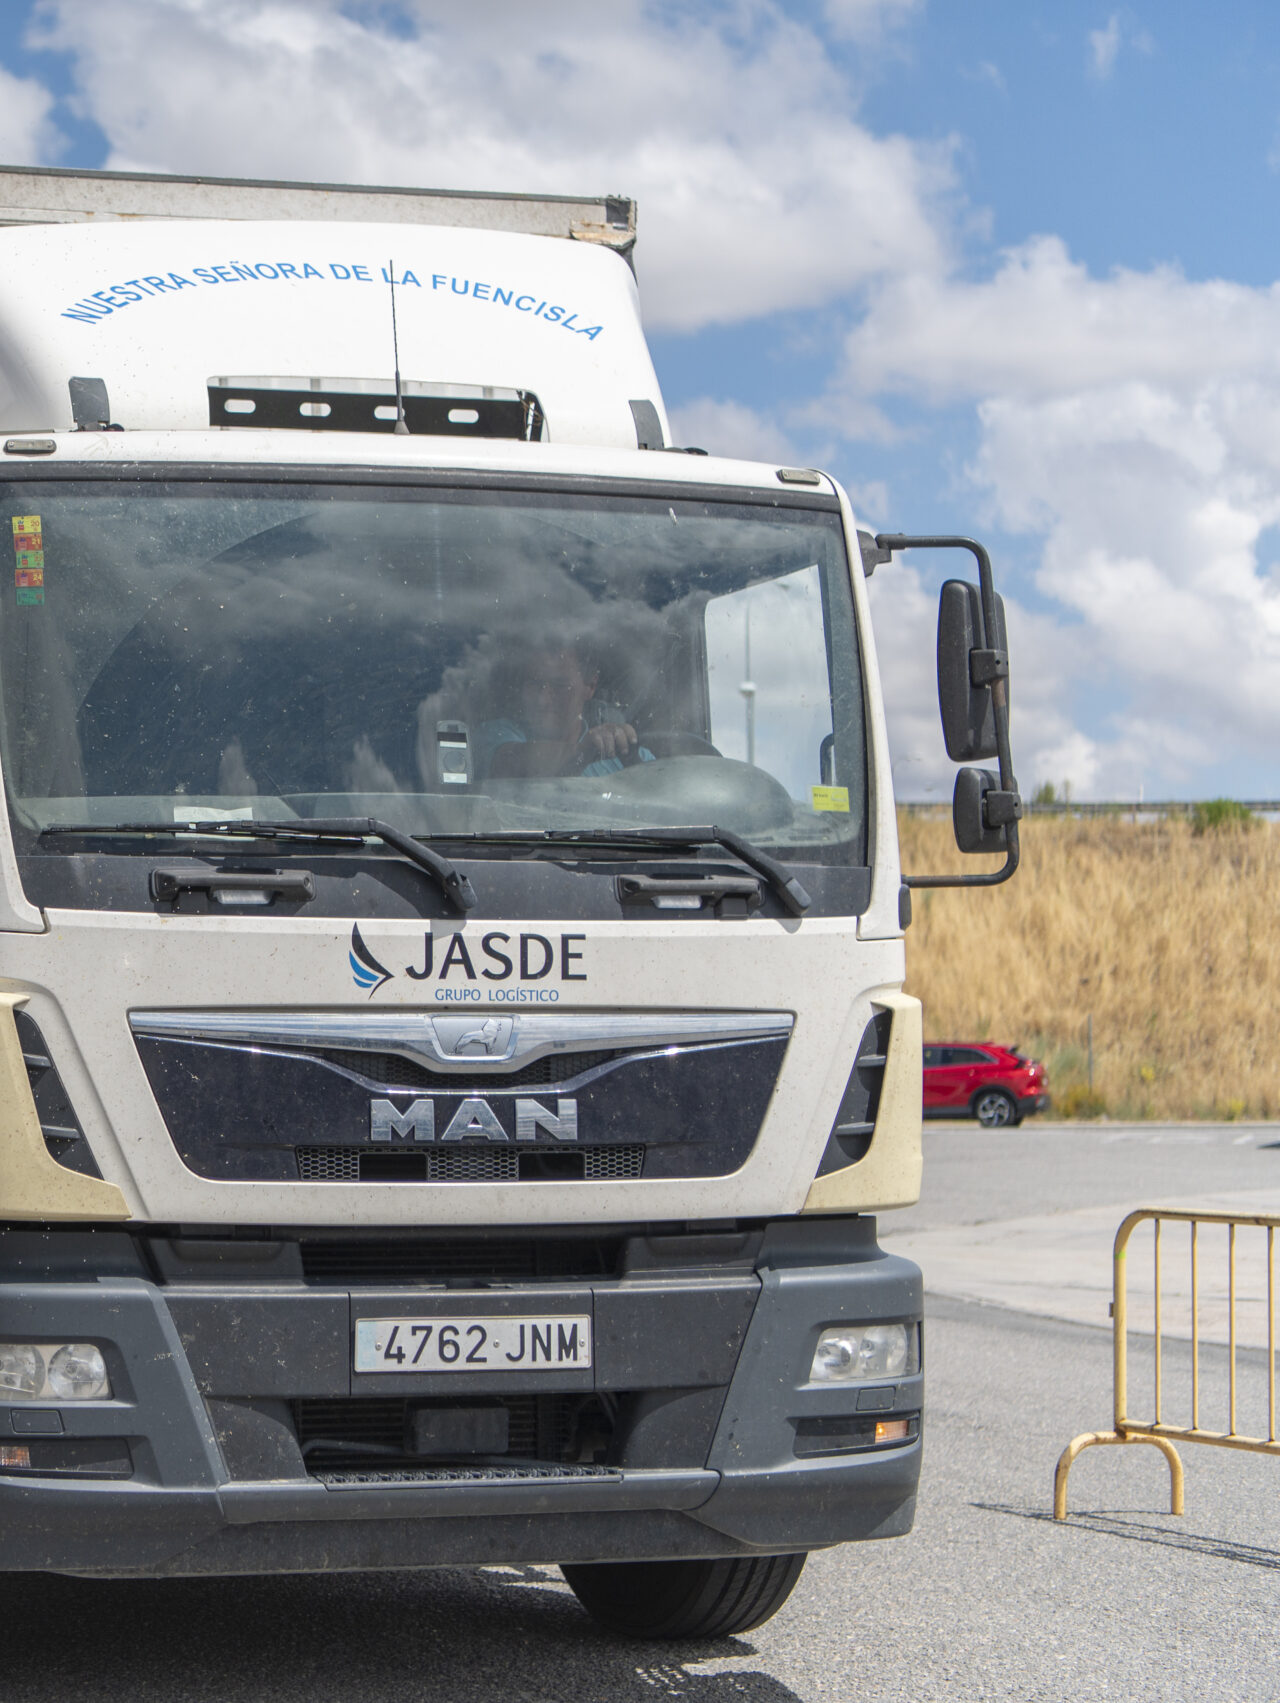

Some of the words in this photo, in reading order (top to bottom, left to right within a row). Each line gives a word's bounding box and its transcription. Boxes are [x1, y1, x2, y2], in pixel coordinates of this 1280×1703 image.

[60, 269, 196, 324] NUESTRA
[193, 259, 324, 285] SEÑORA
[329, 262, 373, 283] DE
[383, 266, 421, 288] LA
[431, 273, 604, 341] FUENCISLA
[404, 931, 588, 981] JASDE
[434, 988, 482, 1001] GRUPO
[488, 986, 559, 1002] LOGÍSTICO
[370, 1098, 579, 1141] MAN
[383, 1325, 488, 1364] 4762
[505, 1323, 579, 1362] JNM
